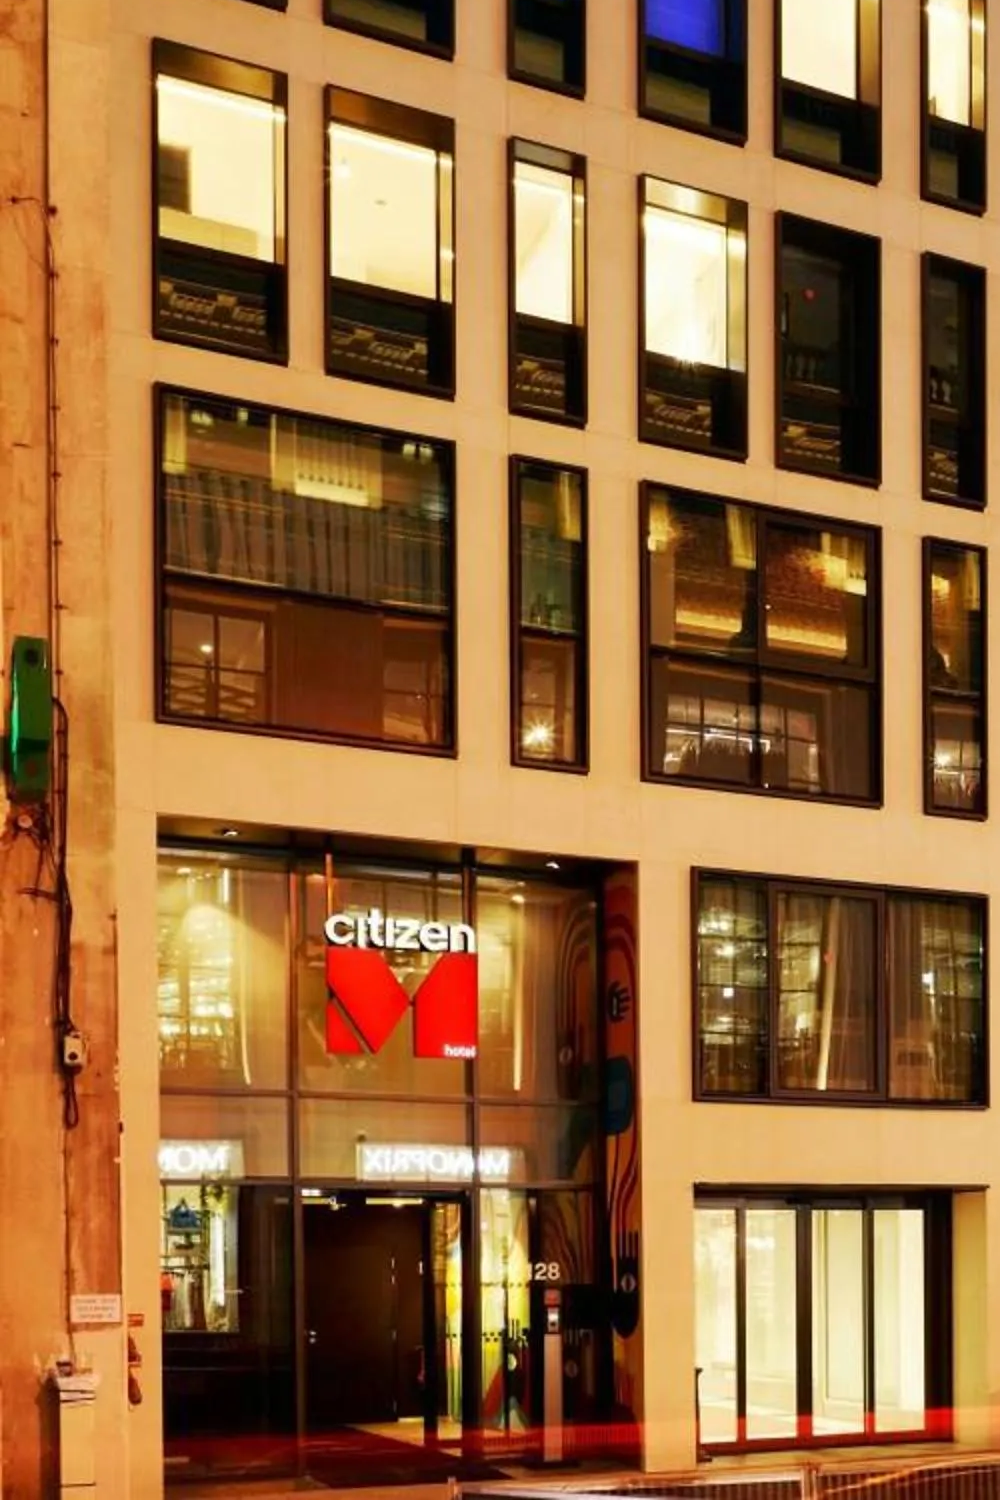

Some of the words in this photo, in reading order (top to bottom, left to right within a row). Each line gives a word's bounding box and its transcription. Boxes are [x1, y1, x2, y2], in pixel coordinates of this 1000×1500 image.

[324, 907, 477, 953] citizen
[326, 946, 478, 1058] M
[443, 1043, 477, 1059] hotel
[527, 1262, 561, 1281] 128
